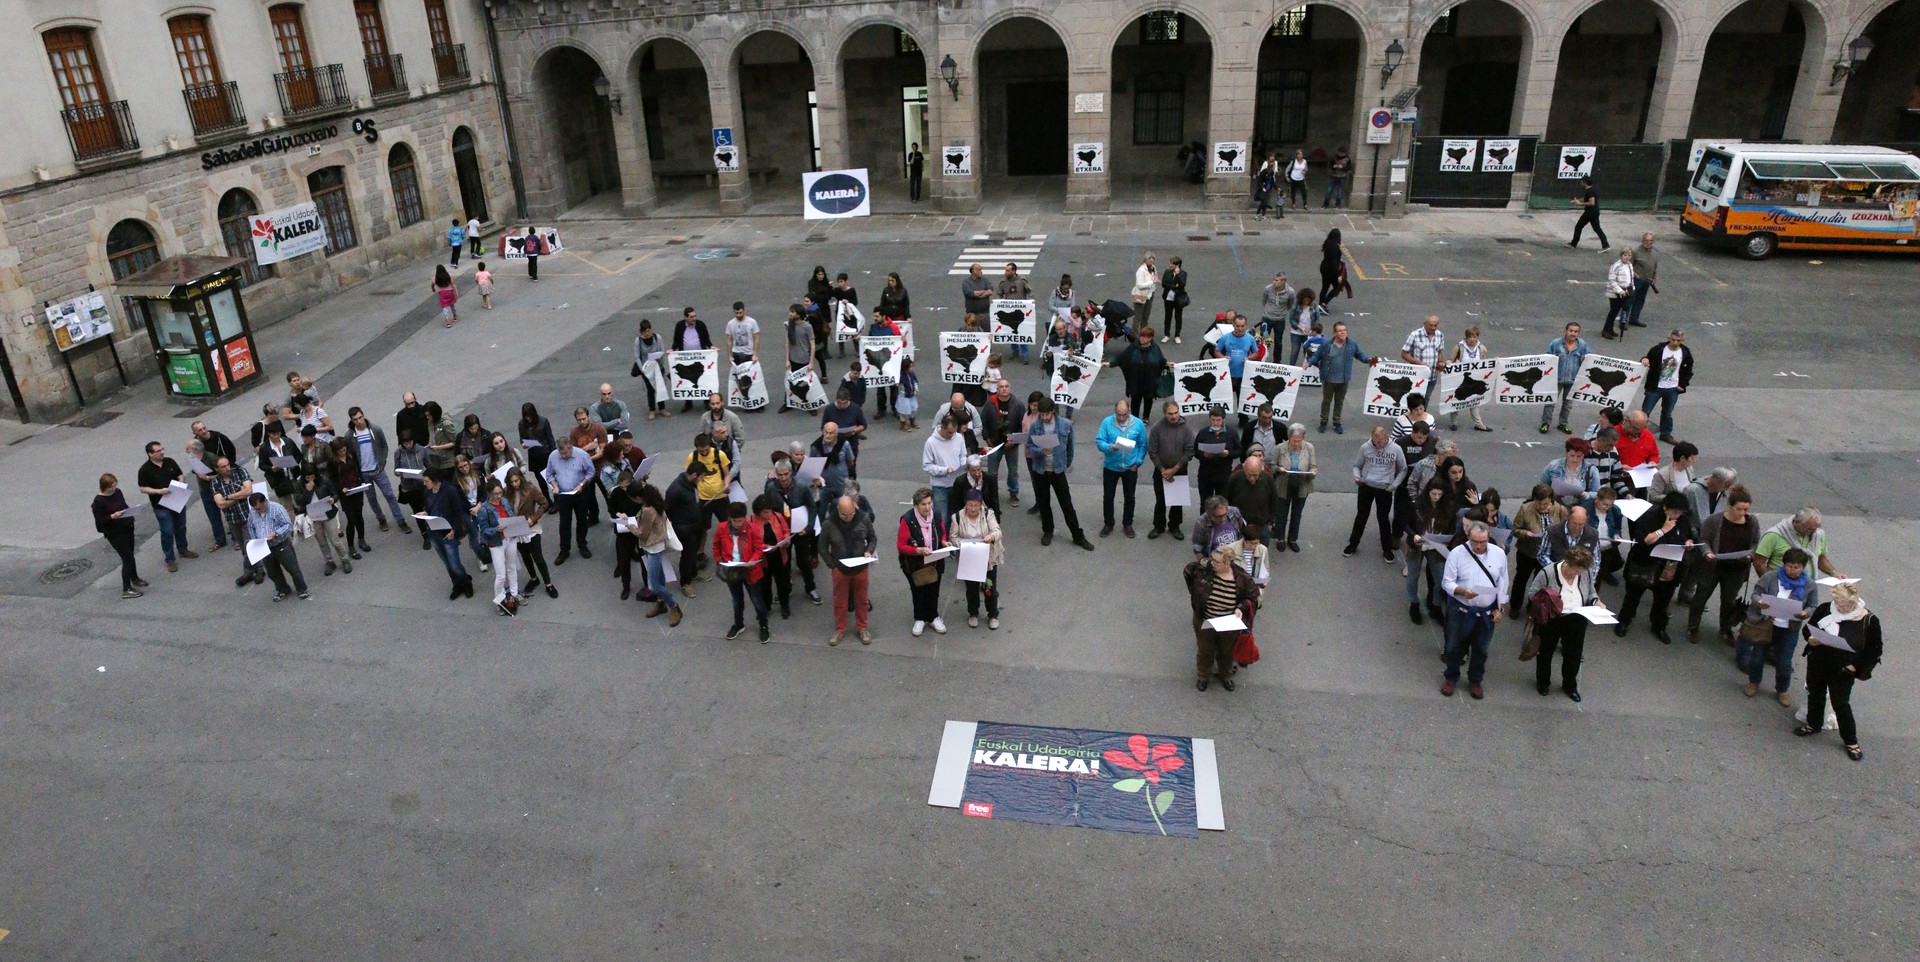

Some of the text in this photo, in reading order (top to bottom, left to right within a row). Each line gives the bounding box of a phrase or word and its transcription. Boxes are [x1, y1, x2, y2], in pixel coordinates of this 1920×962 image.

[270, 213, 292, 227] Euskal
[994, 335, 1033, 343] ETXERA
[1181, 365, 1218, 373] IHESLARIAK
[1446, 360, 1496, 374] ETXERA
[1593, 360, 1634, 372] IHESLARIAK
[1255, 367, 1291, 376] IHESLARIAK
[1379, 368, 1417, 376] IHESLARIAK
[865, 376, 896, 386] ETXERA
[945, 373, 985, 383] ETXERA
[731, 397, 766, 408] ETXERA
[790, 399, 826, 409] ETXERA
[1500, 395, 1553, 403] ETXERA
[1572, 392, 1625, 409] ETXERA
[1243, 404, 1289, 418] ETRA
[1367, 404, 1408, 416] ETXER
[978, 739, 1100, 758] Euskal Udaberria
[974, 750, 1100, 775] KALERA!
[968, 803, 989, 812] free
